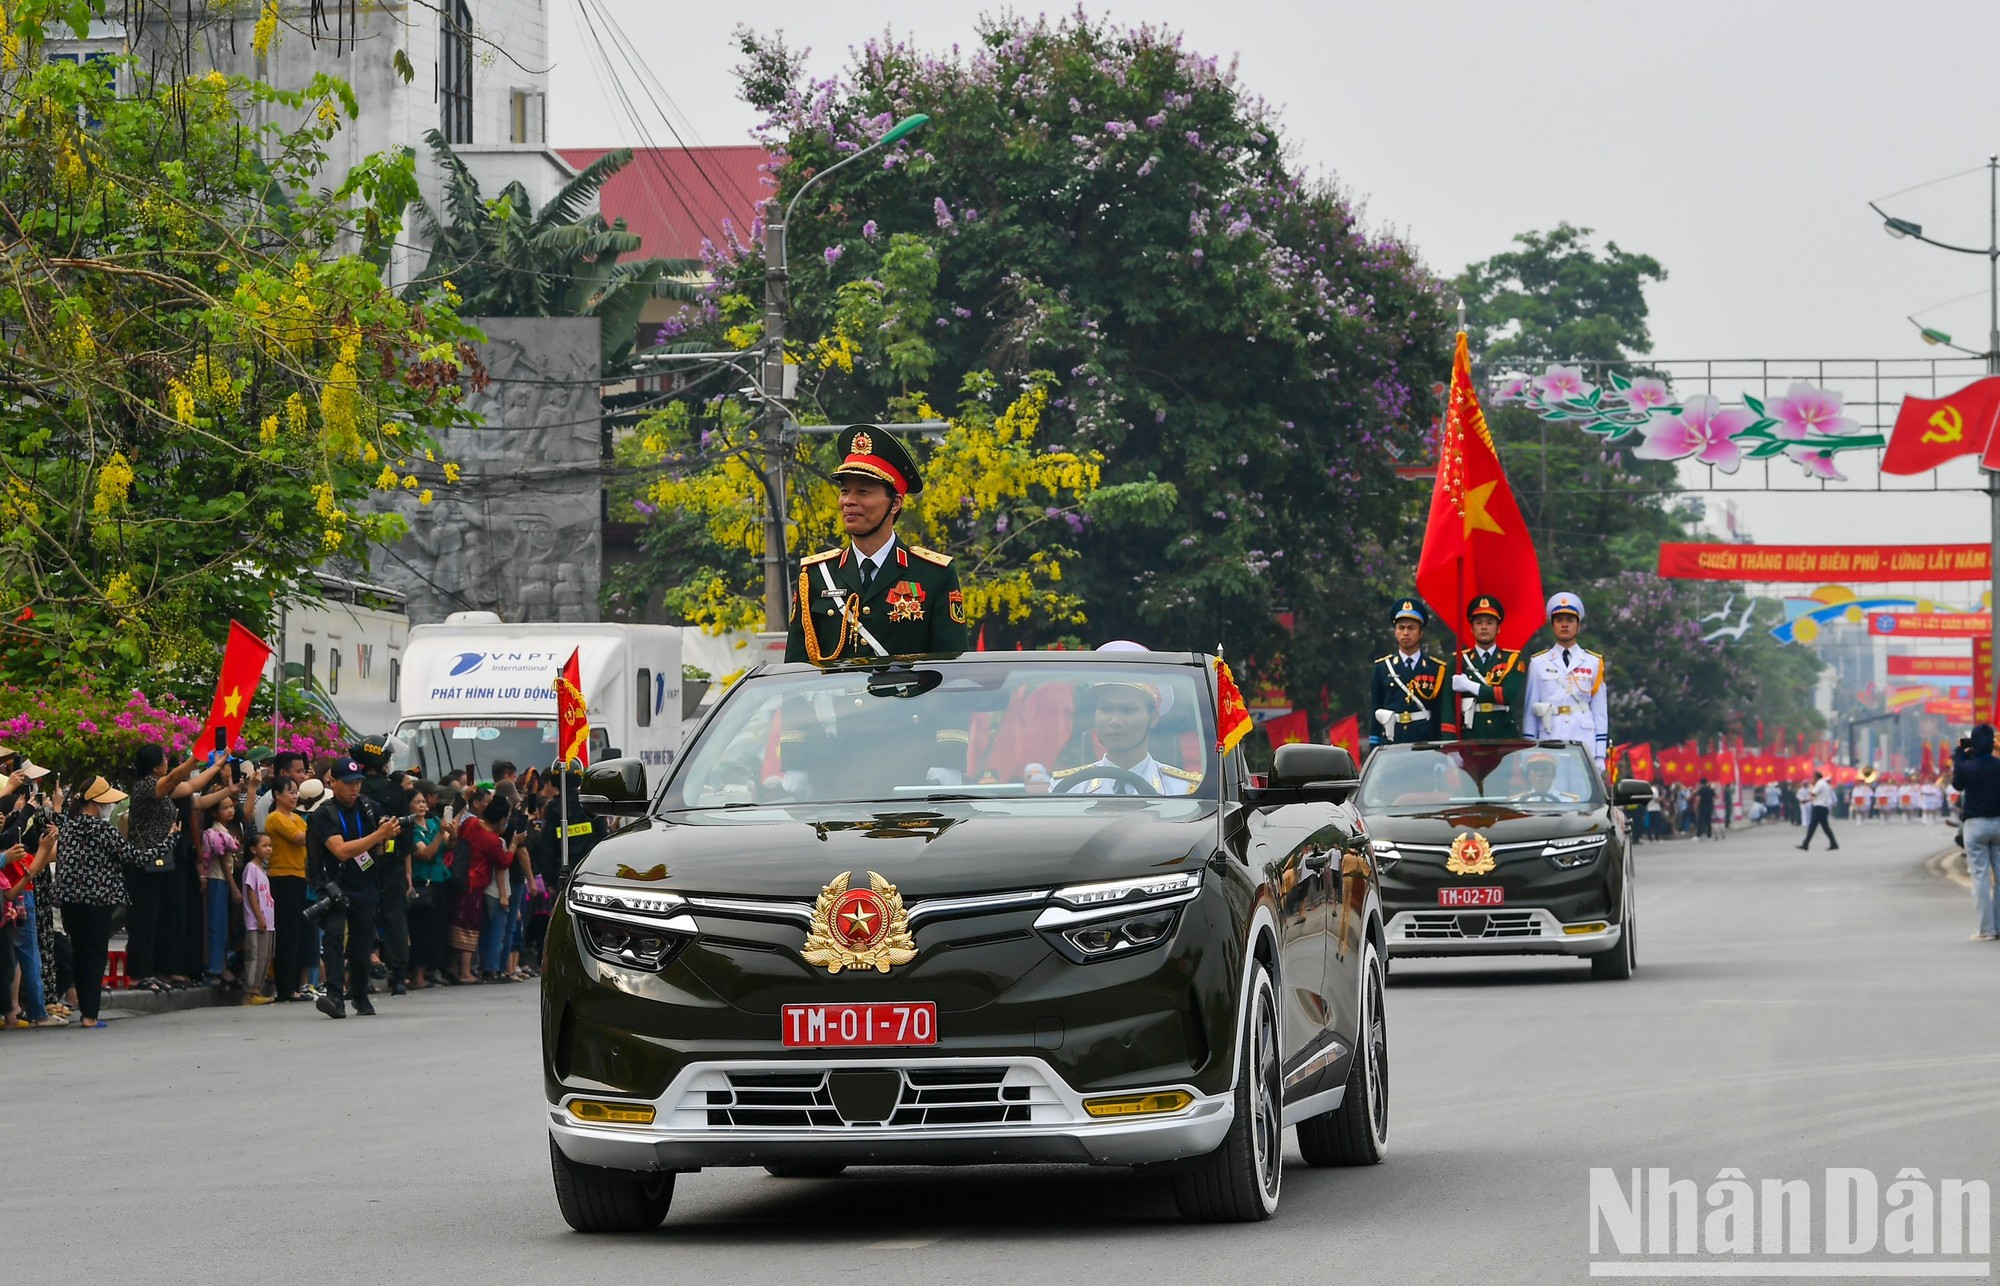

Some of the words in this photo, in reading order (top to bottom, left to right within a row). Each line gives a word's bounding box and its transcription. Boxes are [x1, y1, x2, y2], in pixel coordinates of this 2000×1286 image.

[1699, 551, 1737, 569] CHIẾN
[1741, 551, 1783, 570] THẮNG
[1853, 551, 1879, 570] PHỦ
[1955, 550, 1986, 569] NĂM
[492, 664, 548, 672] International
[431, 685, 462, 699] PHÁT
[465, 685, 495, 698] HÌNH
[498, 686, 520, 698] LƯU
[524, 685, 557, 701] ĐỘNG
[459, 720, 517, 728] MITSUBISHI
[567, 825, 588, 835] SCĐ
[1441, 889, 1501, 904] TM-02-70
[788, 1007, 930, 1042] TM-01-70
